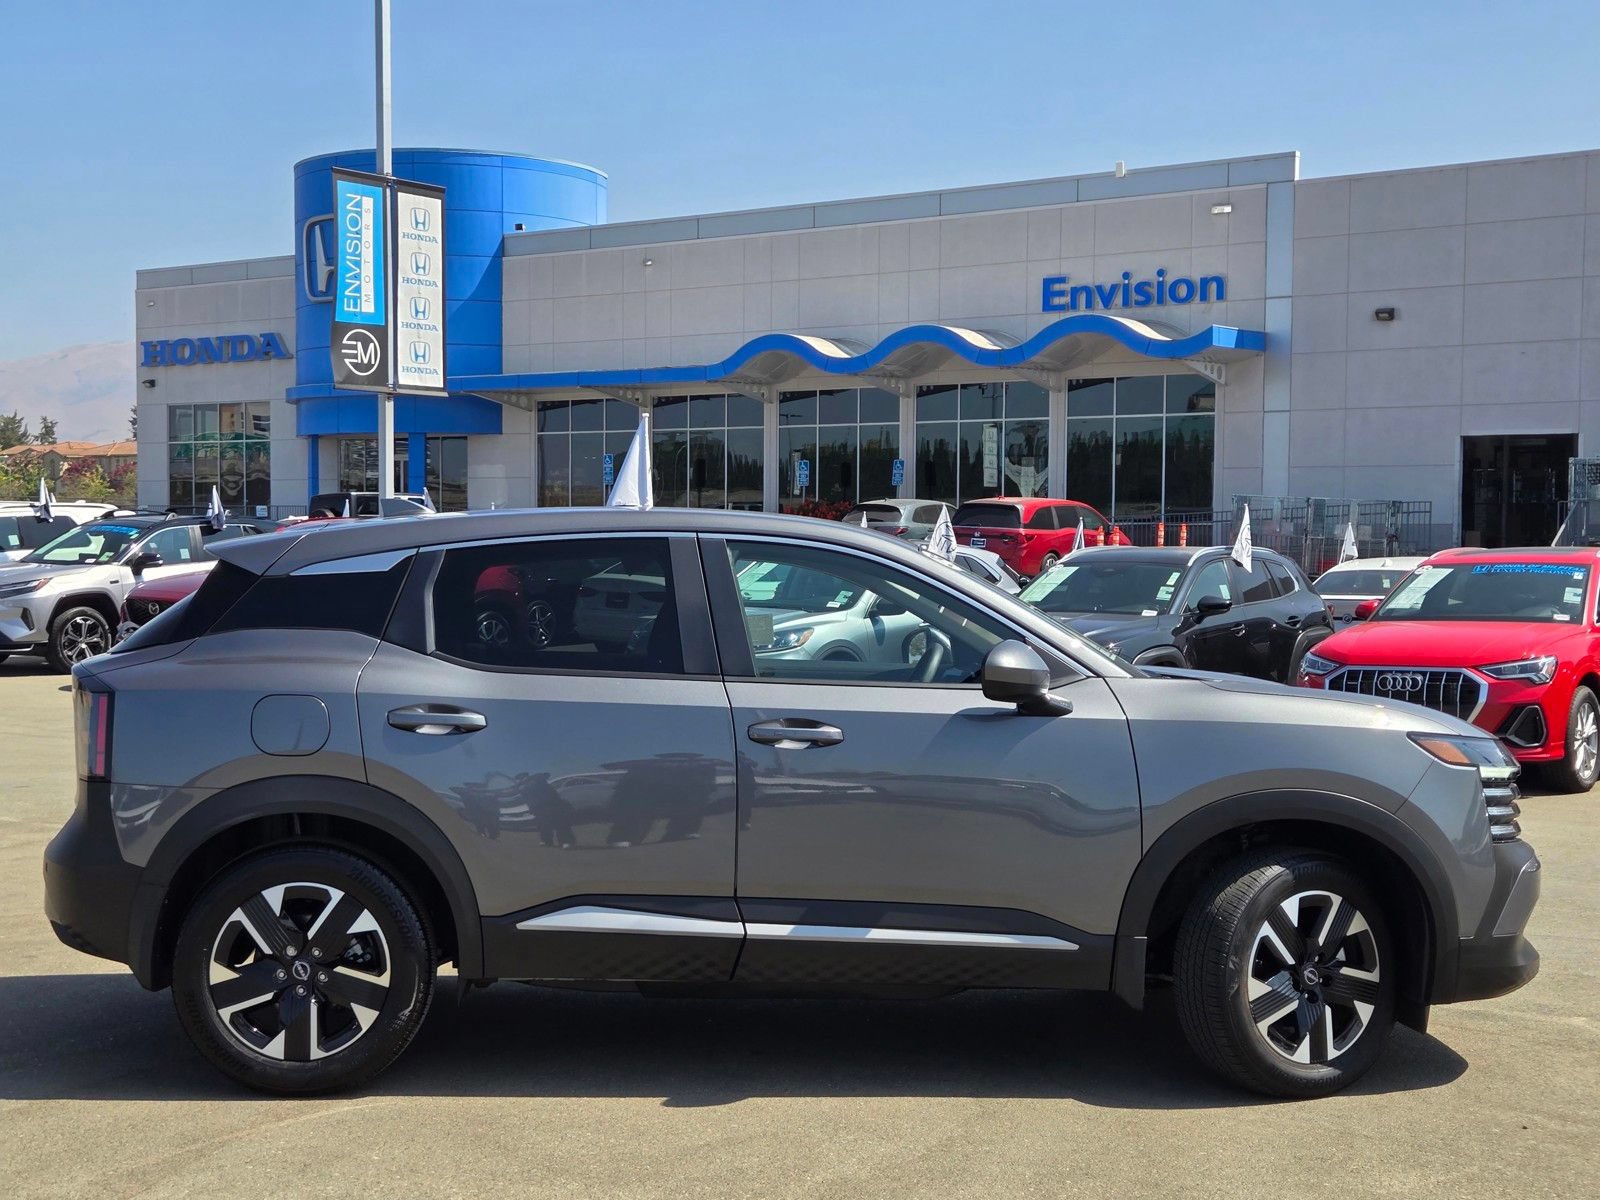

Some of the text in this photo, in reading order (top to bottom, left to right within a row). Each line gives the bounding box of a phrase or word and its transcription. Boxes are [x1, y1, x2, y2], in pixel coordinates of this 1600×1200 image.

[401, 231, 438, 244] HONDA
[343, 193, 361, 312] ENVISION
[364, 208, 372, 303] MOTORS
[401, 276, 438, 288] HONDA
[1042, 268, 1226, 312] Envision
[401, 321, 438, 332] HONDA
[140, 332, 294, 368] HONDA
[401, 365, 439, 375] HONDA
